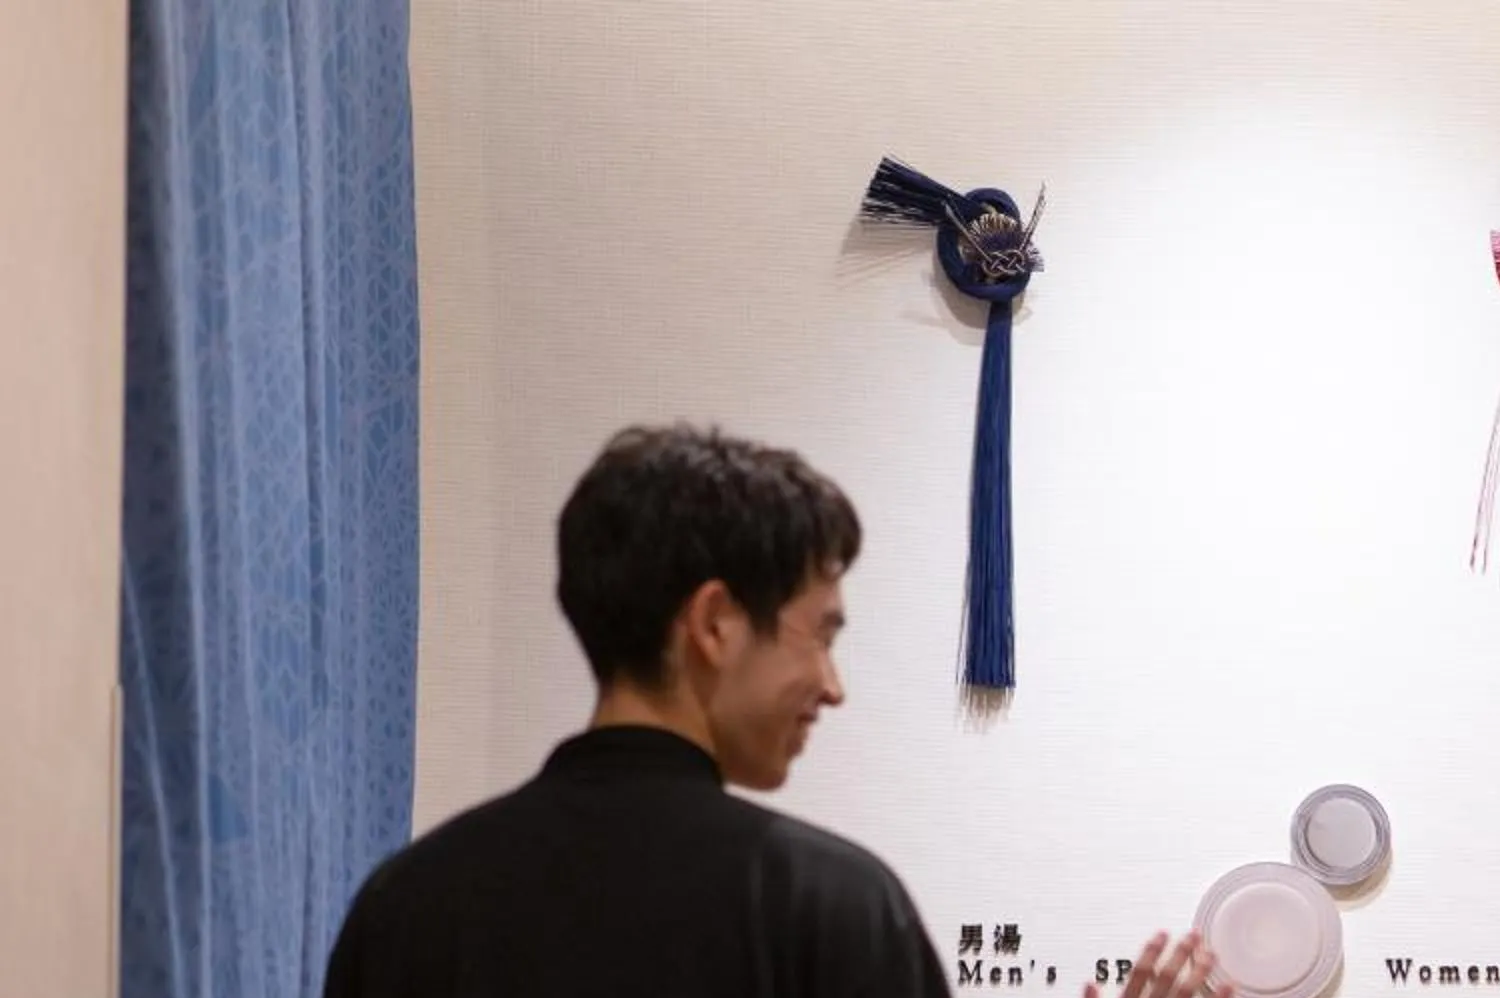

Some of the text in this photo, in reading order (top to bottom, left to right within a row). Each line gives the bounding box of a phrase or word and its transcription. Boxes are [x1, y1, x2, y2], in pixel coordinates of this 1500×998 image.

[958, 924, 1021, 954] 男湯
[958, 959, 1136, 984] Men's SP
